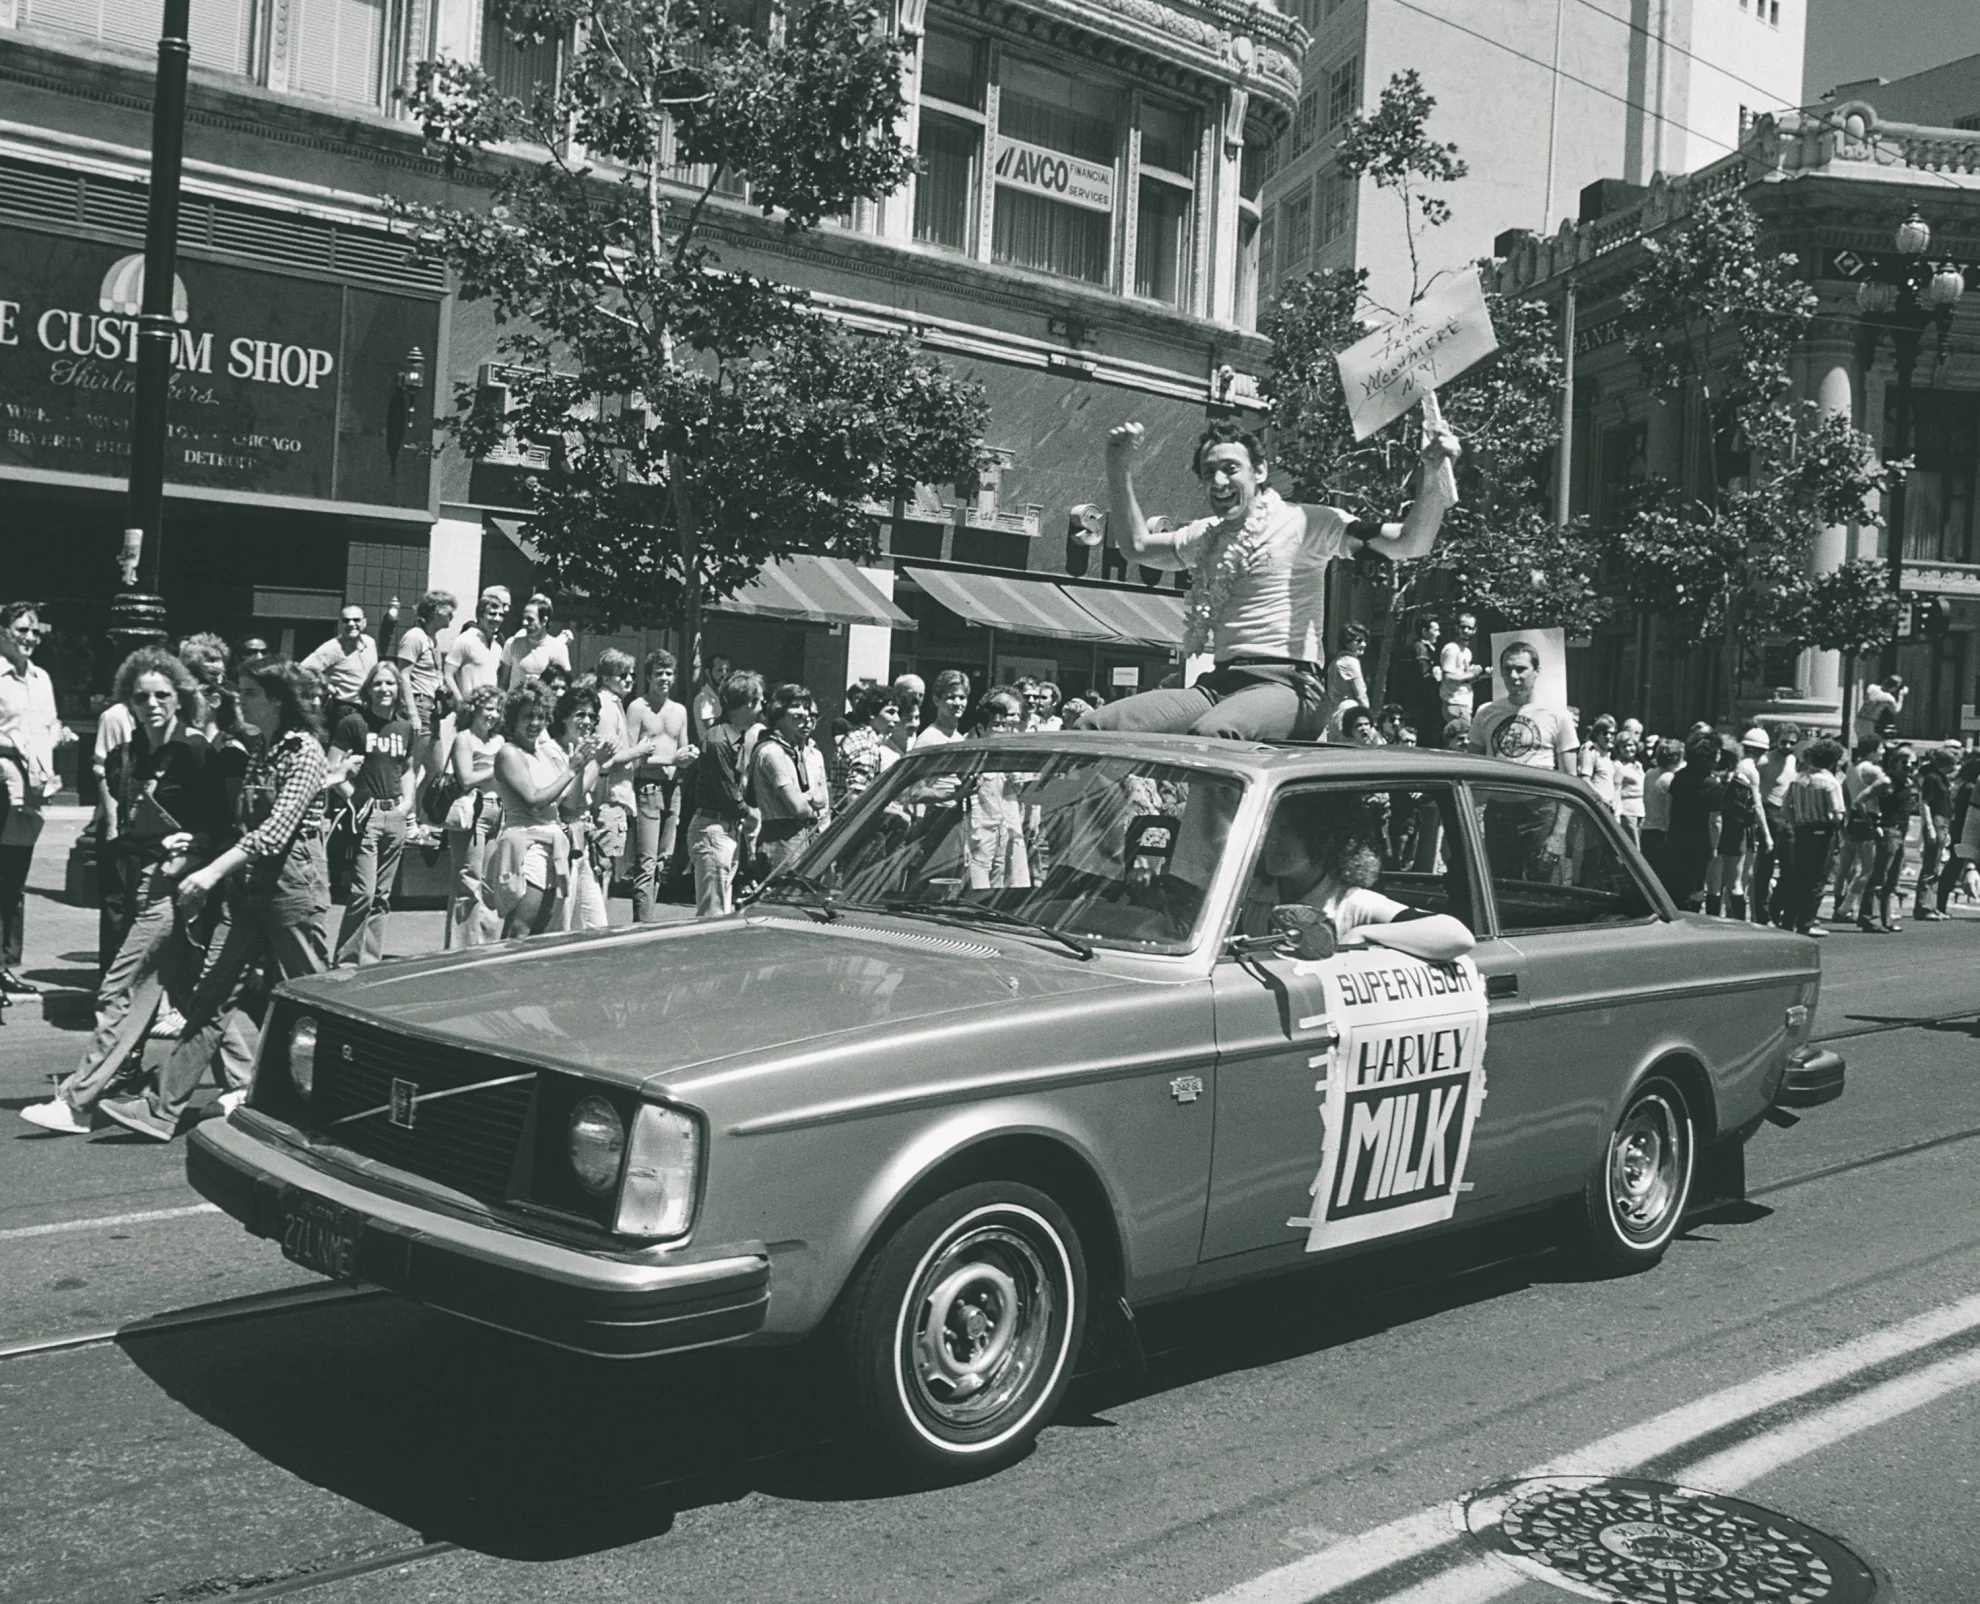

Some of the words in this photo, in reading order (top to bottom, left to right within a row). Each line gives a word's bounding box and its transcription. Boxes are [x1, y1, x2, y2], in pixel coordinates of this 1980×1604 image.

[1013, 150, 1069, 193] AVCO
[1069, 163, 1109, 185] FINANCIAL
[1068, 185, 1109, 206] SERVICES
[37, 308, 215, 374] CUSTM
[228, 336, 334, 389] SHOP
[50, 357, 221, 406] Shirtmkers
[1336, 961, 1473, 1006] SUPERVISOR
[1357, 1026, 1470, 1085] HARVEY
[1336, 1084, 1463, 1208] MILK
